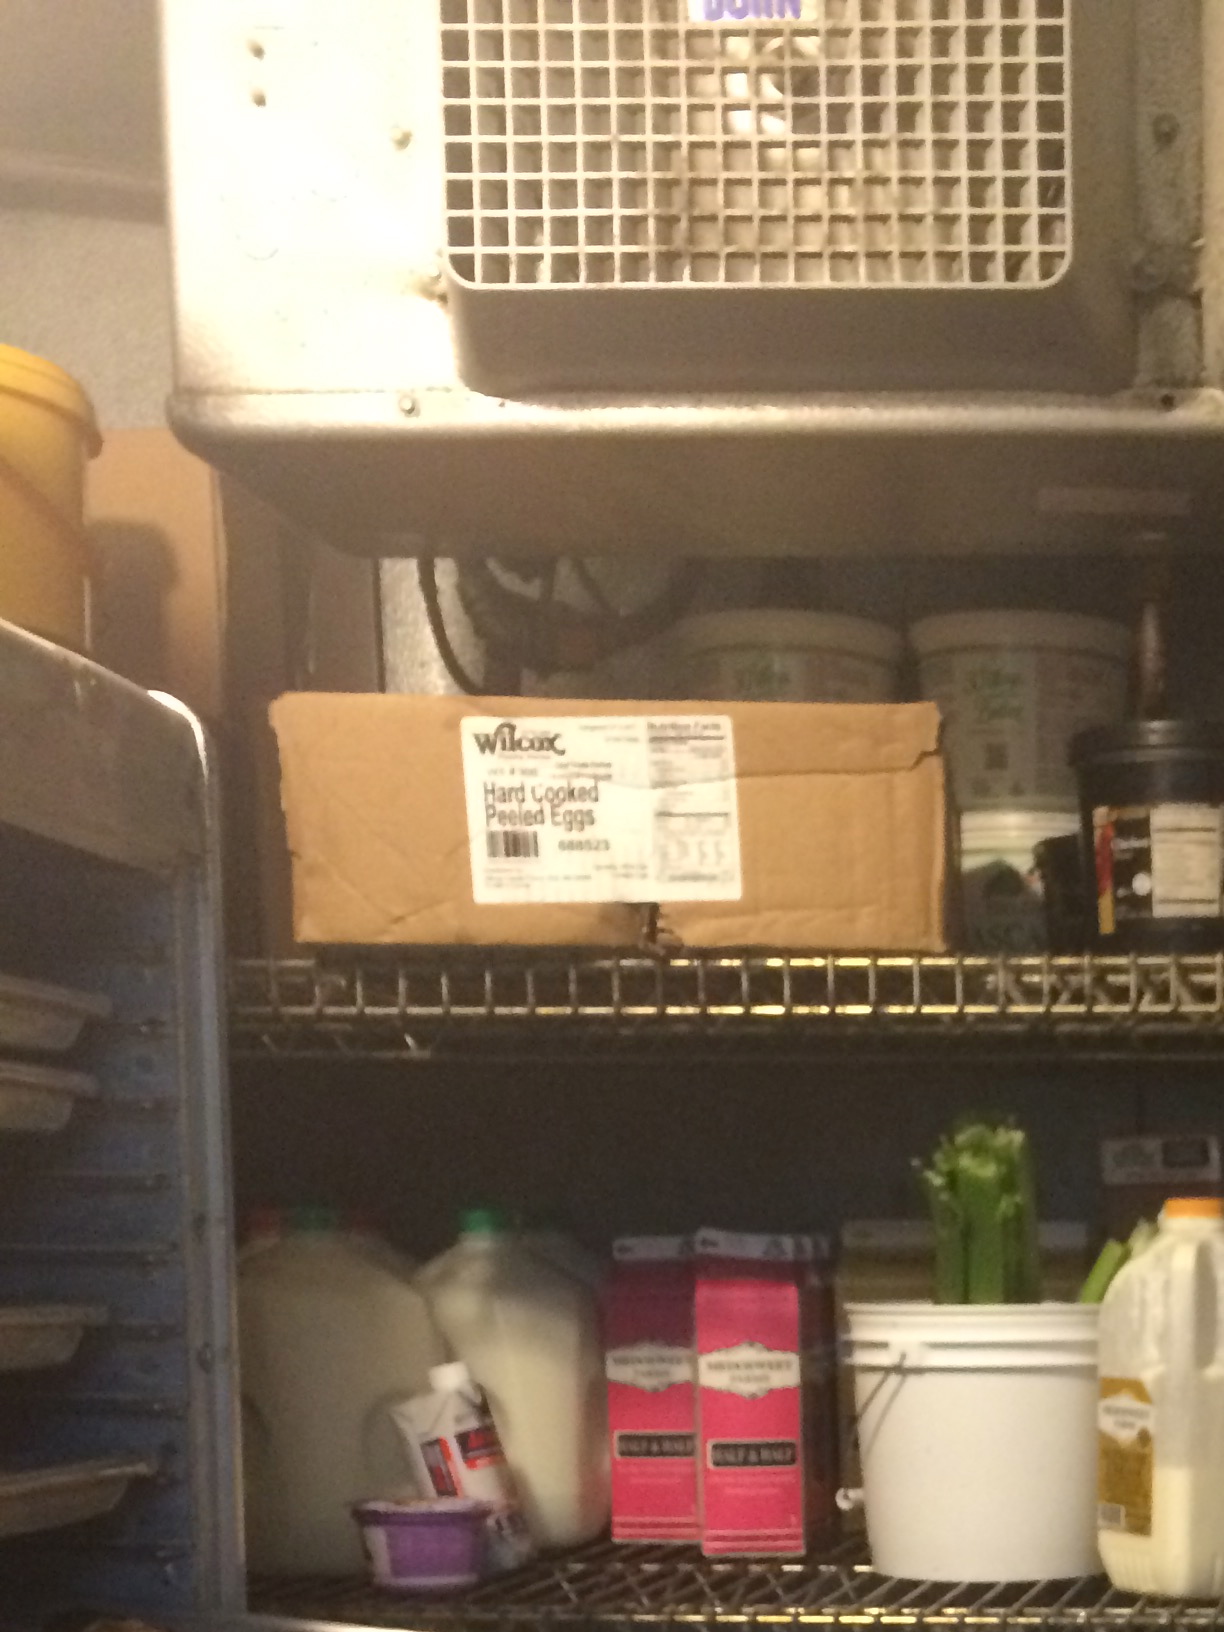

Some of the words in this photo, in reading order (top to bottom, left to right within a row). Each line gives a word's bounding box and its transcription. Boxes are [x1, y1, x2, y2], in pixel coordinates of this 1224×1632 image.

[473, 722, 566, 756] Wilcox
[483, 781, 525, 803] Hard
[530, 778, 599, 805] Cooked
[485, 804, 545, 827] Peeled
[550, 805, 595, 832] Eggs
